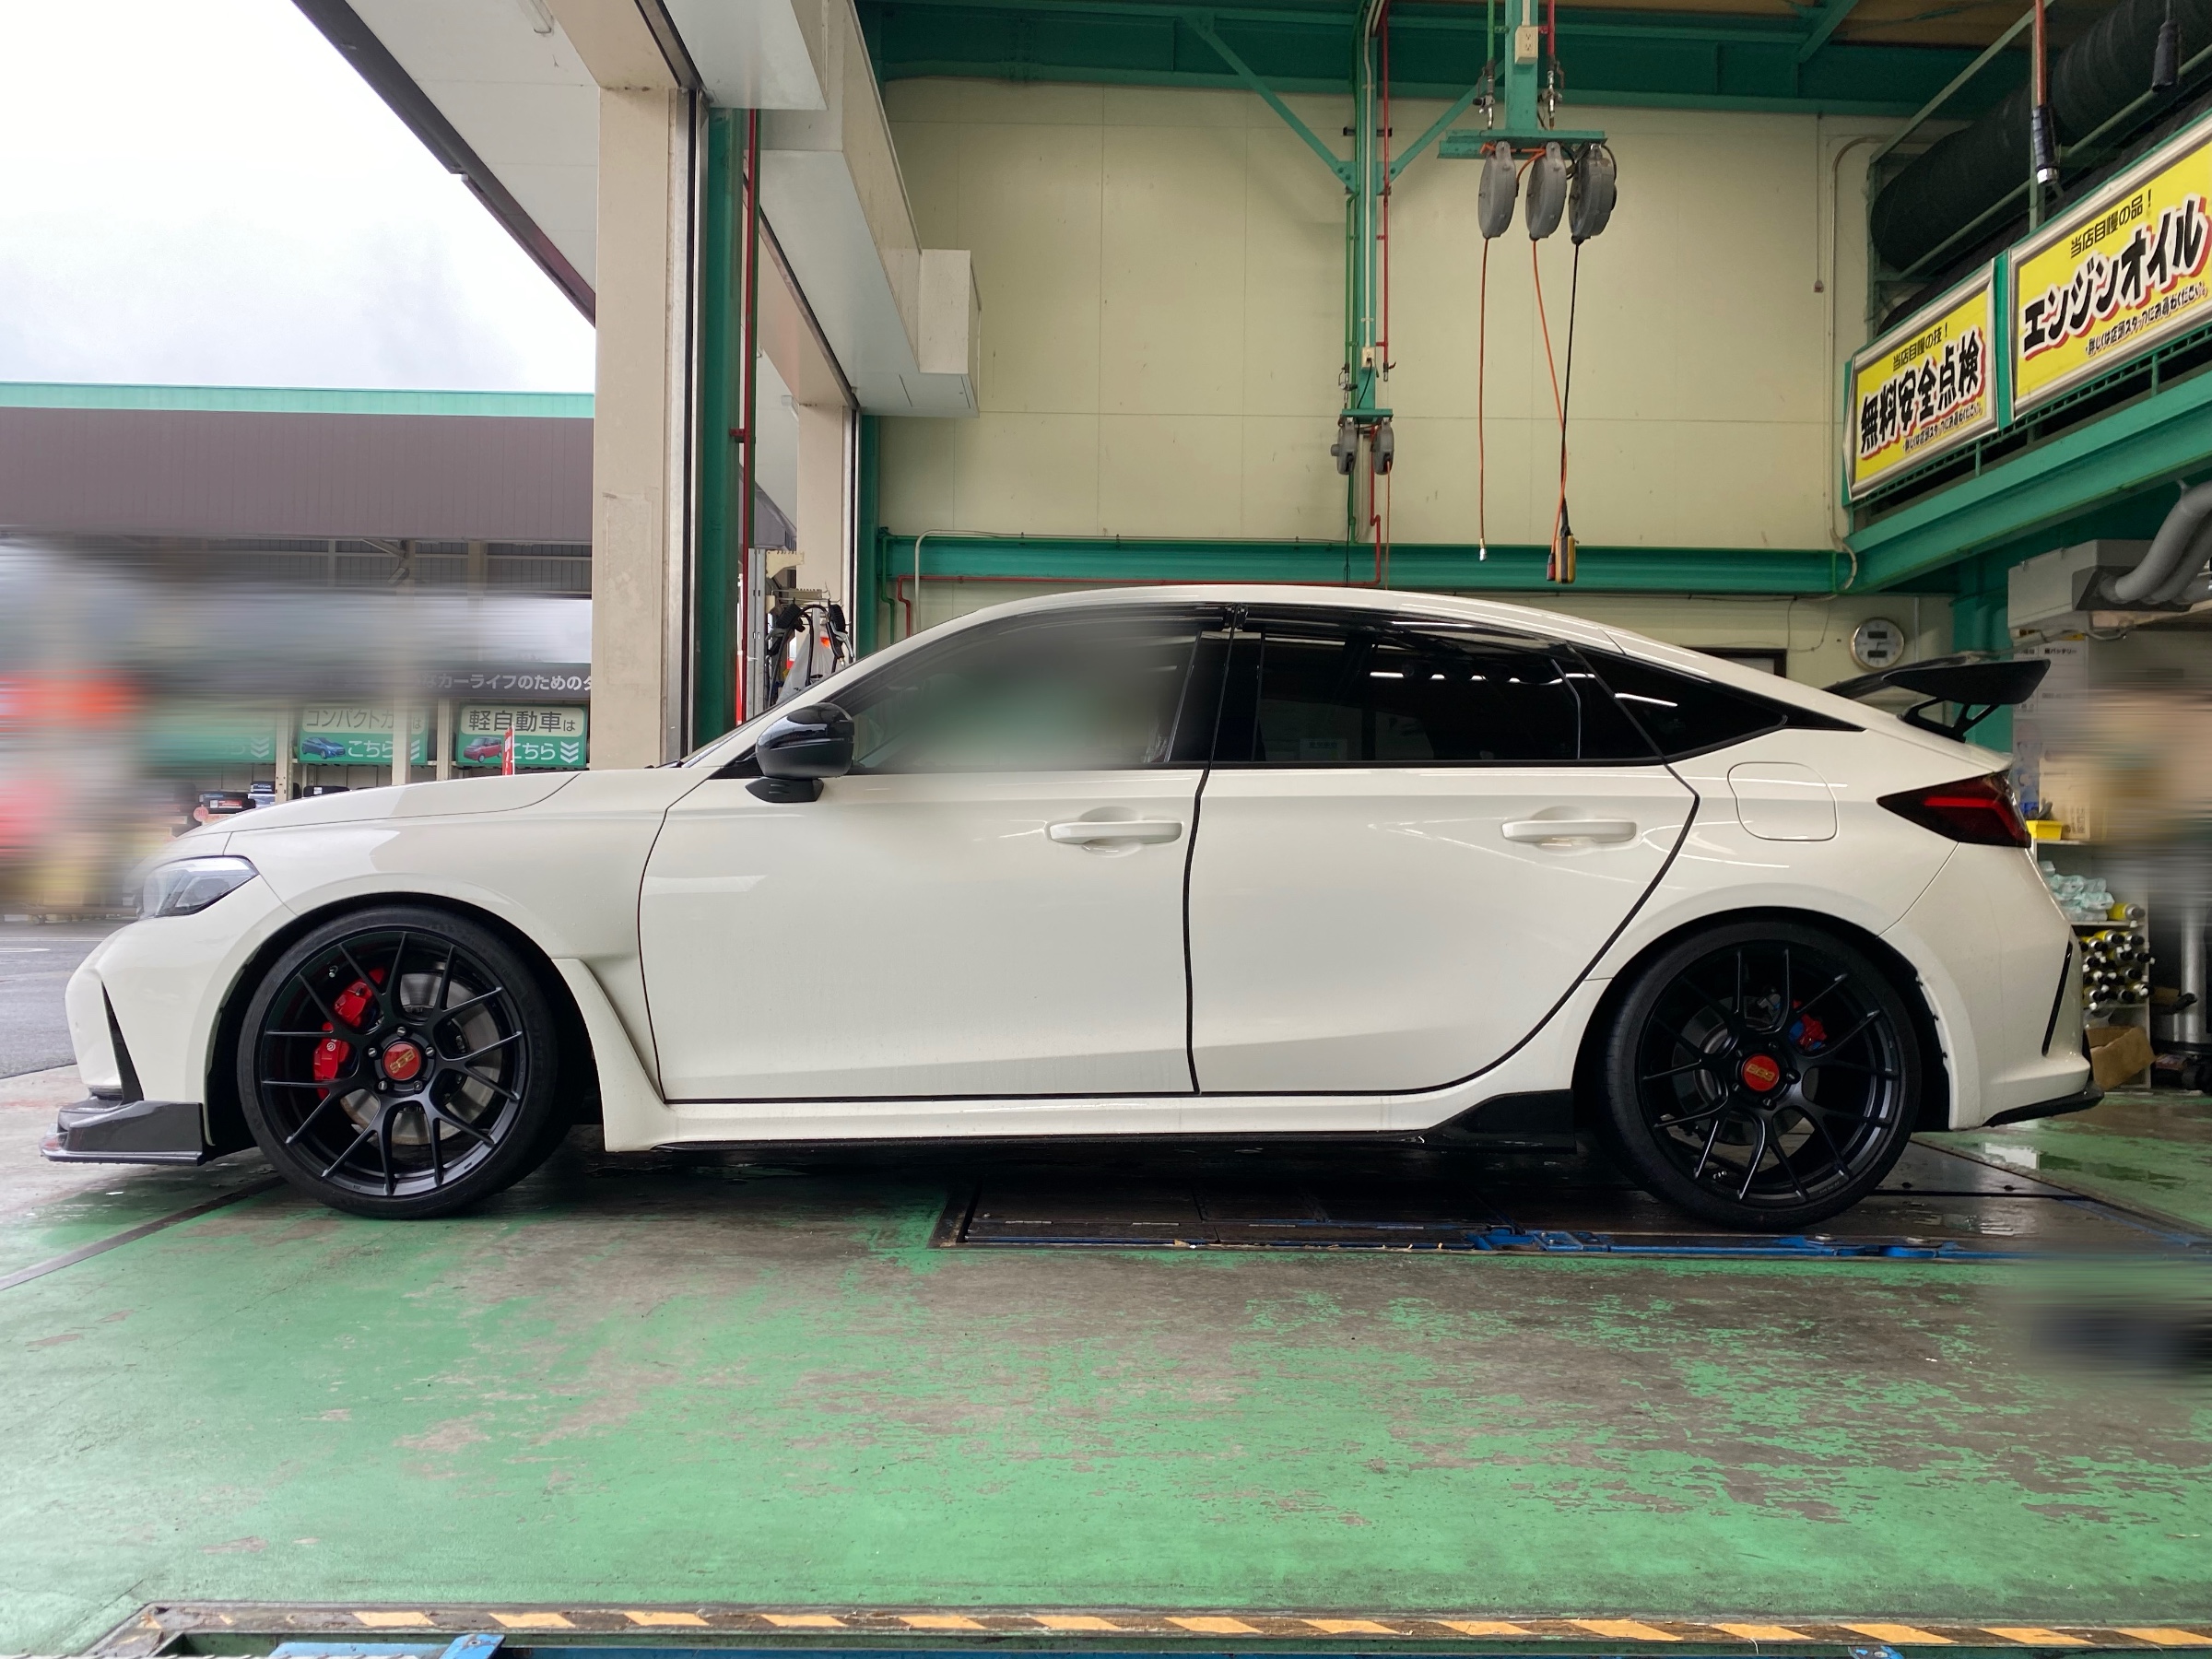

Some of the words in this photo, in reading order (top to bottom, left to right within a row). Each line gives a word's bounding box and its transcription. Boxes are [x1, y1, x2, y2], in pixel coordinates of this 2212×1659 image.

[2024, 199, 2204, 353] エンジンオイル
[1861, 330, 1980, 454] 無料安全点検
[307, 708, 421, 730] コンパクトカは
[390, 1048, 416, 1074] BBS
[1747, 1063, 1776, 1082] BBS
